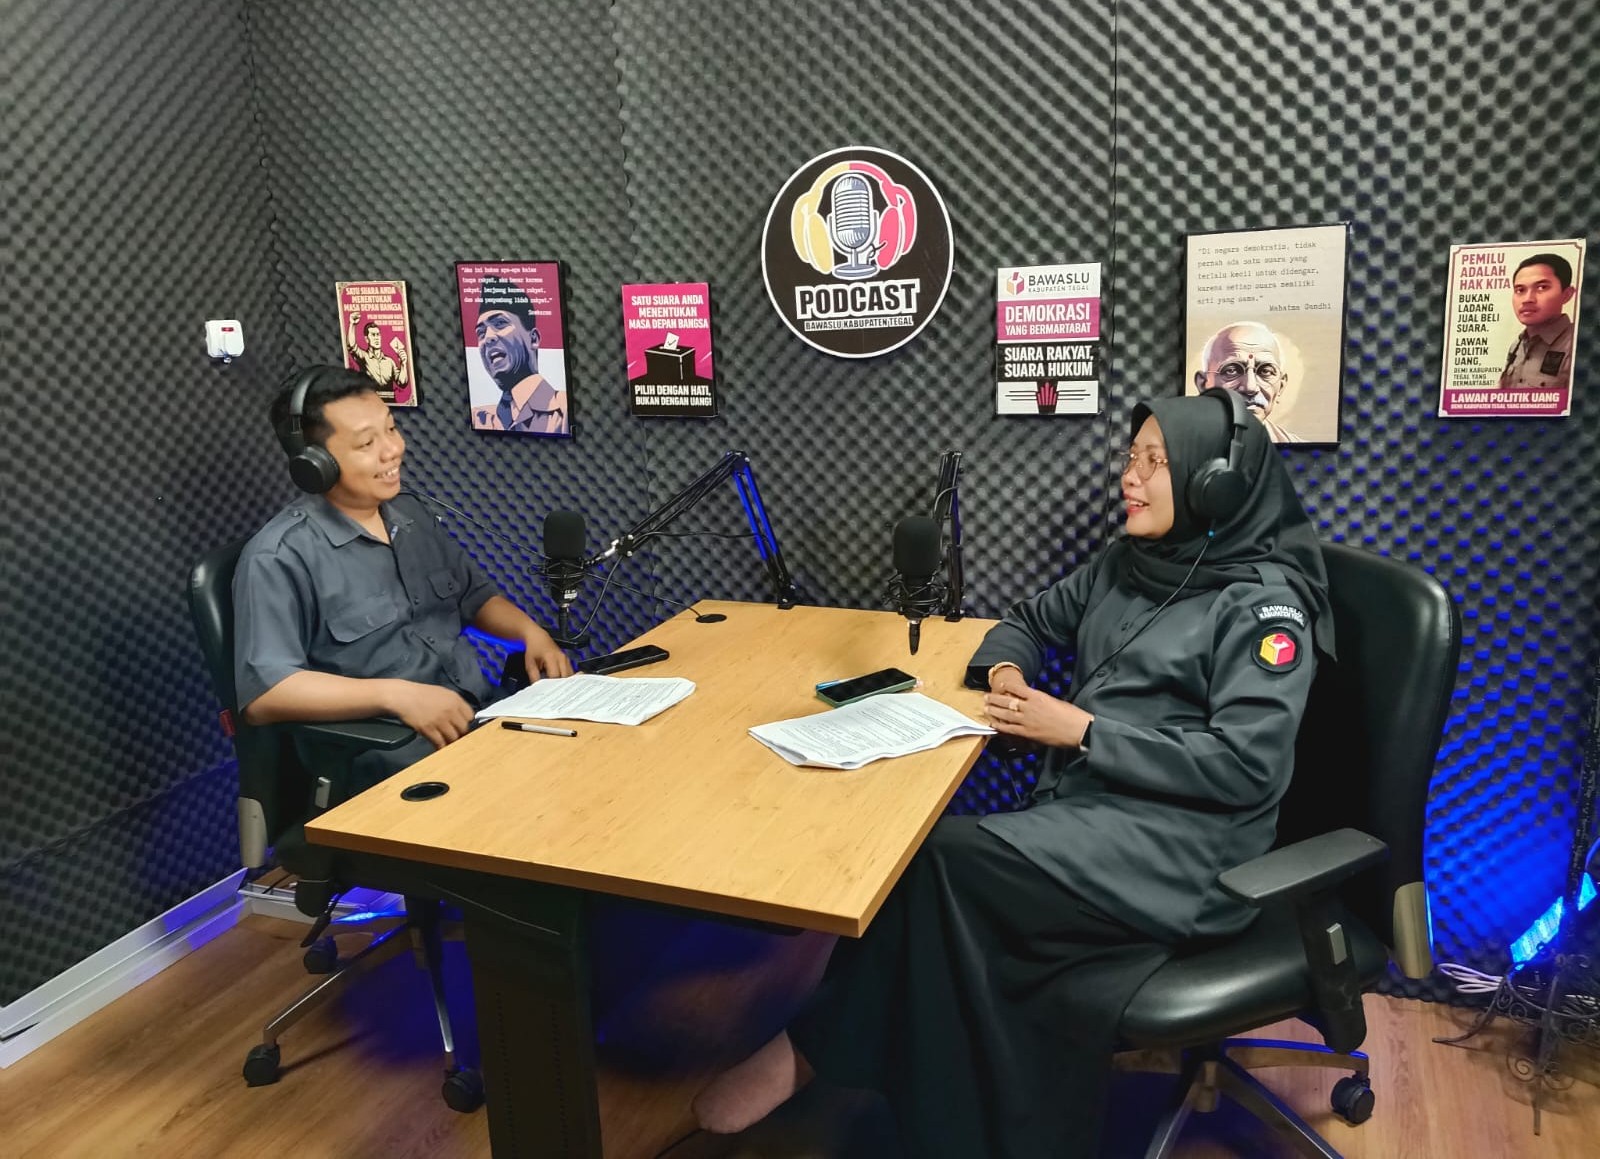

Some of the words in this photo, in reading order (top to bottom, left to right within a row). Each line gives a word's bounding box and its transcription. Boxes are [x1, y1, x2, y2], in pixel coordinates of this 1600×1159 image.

[1461, 253, 1505, 265] PEMILU
[1231, 270, 1252, 278] kecil
[1460, 265, 1506, 278] ADALAH
[1028, 272, 1090, 286] BAWASLU
[1460, 279, 1484, 290] HAK
[1486, 278, 1511, 289] KITA
[352, 295, 392, 304] MENENTUKAN
[631, 295, 652, 305] SATU
[653, 295, 680, 305] SUARA
[682, 294, 704, 305] ANDA
[797, 281, 918, 317] PODCAST
[1459, 294, 1490, 303] BUKAN
[380, 303, 402, 311] BANGSA
[639, 307, 697, 318] MENENTUKAN
[1458, 303, 1494, 312] LADANG
[1005, 303, 1090, 323] DEMOKRASI
[1457, 314, 1479, 323] JUAL
[1480, 313, 1500, 322] BELI
[628, 319, 652, 329] MASA
[653, 319, 677, 329] DEPAN
[678, 319, 709, 329] BANGSA
[805, 320, 842, 330] BAWASLU
[843, 318, 889, 328] KABUPATEN
[889, 316, 913, 326] TEGAL
[1457, 324, 1489, 333] SUARA.
[1005, 324, 1028, 336] YANG
[1029, 322, 1092, 335] BERMARTABAT
[1456, 338, 1488, 346] LAWAN
[1004, 347, 1044, 362] SUARA
[1046, 345, 1094, 361] RAKYAT,
[1455, 347, 1489, 356] POLITIK
[1454, 357, 1482, 366] UANG,
[1004, 363, 1045, 377] SUARA
[1047, 362, 1093, 376] HUKUM
[634, 385, 656, 395] PILIH
[657, 385, 689, 395] DENGAN
[691, 385, 712, 396] HATI,
[635, 396, 660, 405] BUKAN
[661, 397, 689, 406] DENGAN
[690, 397, 712, 406] UANG!
[1451, 393, 1489, 403] LAWAN
[1490, 393, 1530, 402] POLITIK
[1531, 392, 1560, 402] UANG
[1262, 605, 1303, 617] BAWASLU
